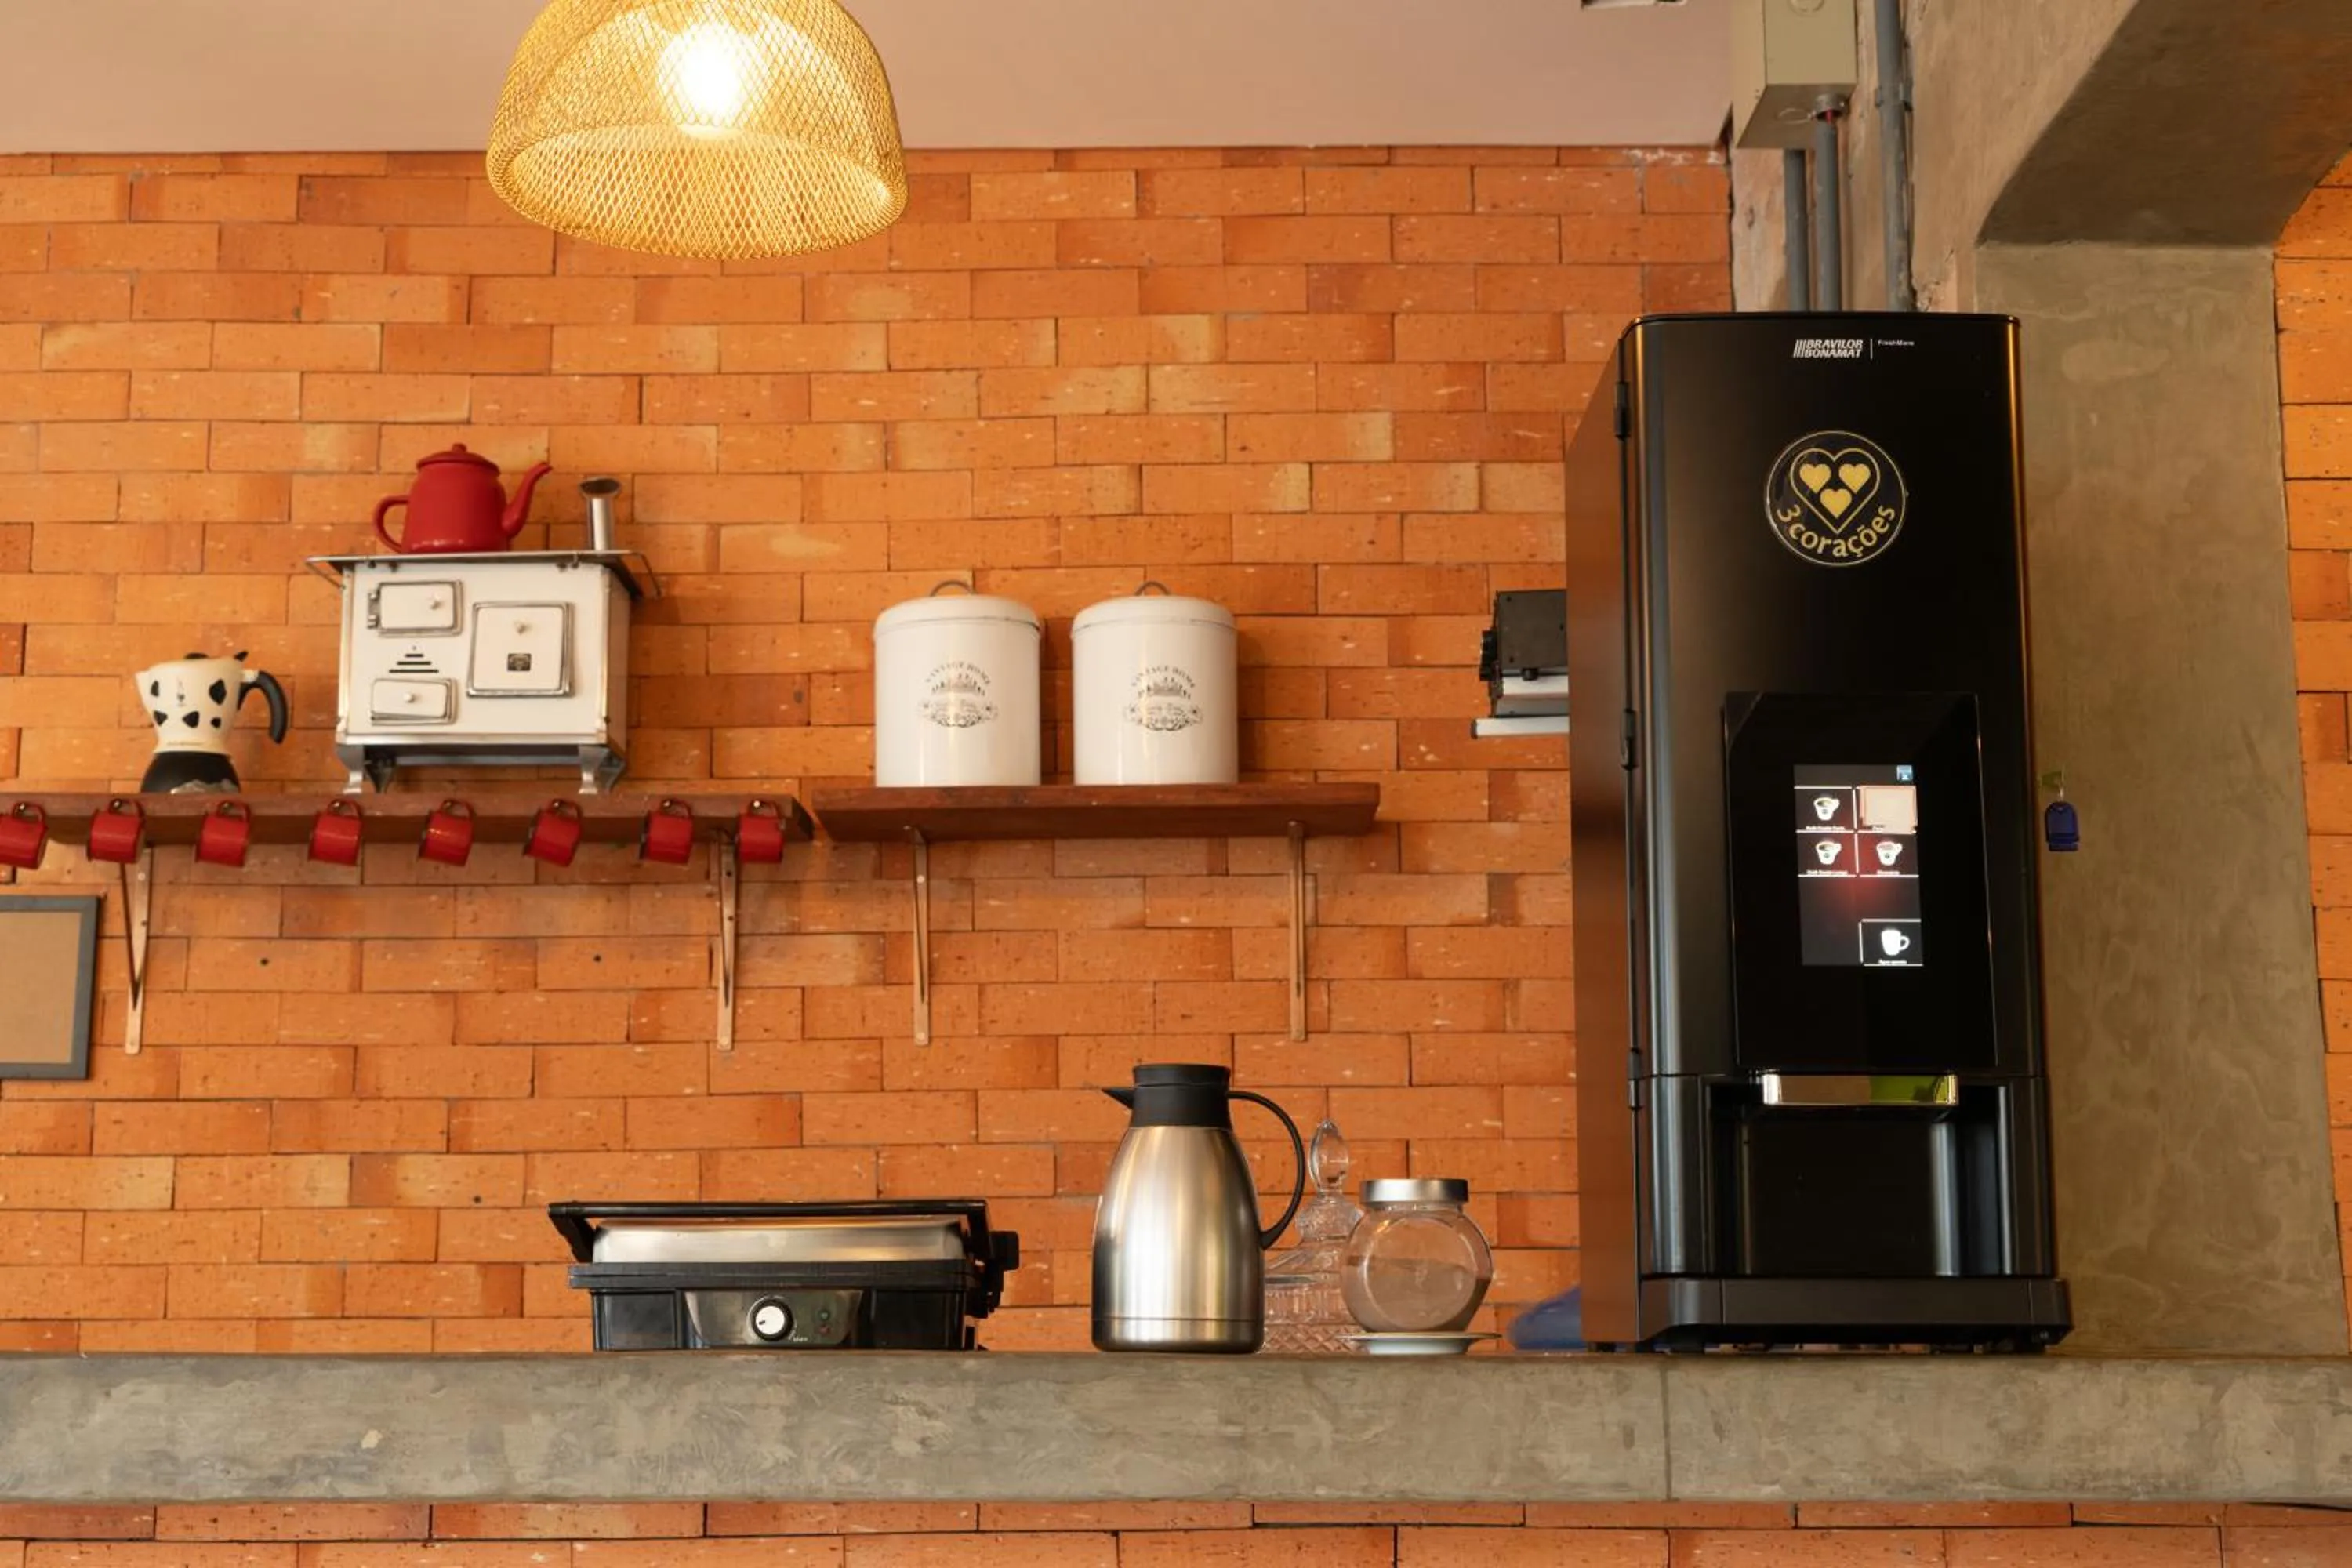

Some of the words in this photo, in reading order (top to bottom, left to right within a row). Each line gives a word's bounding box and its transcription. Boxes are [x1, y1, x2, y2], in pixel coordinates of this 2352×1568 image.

[1806, 339, 1864, 349] BRAVILOR
[1805, 349, 1861, 358] BONAMAT
[1776, 504, 1801, 523] 3
[1788, 504, 1896, 557] corações
